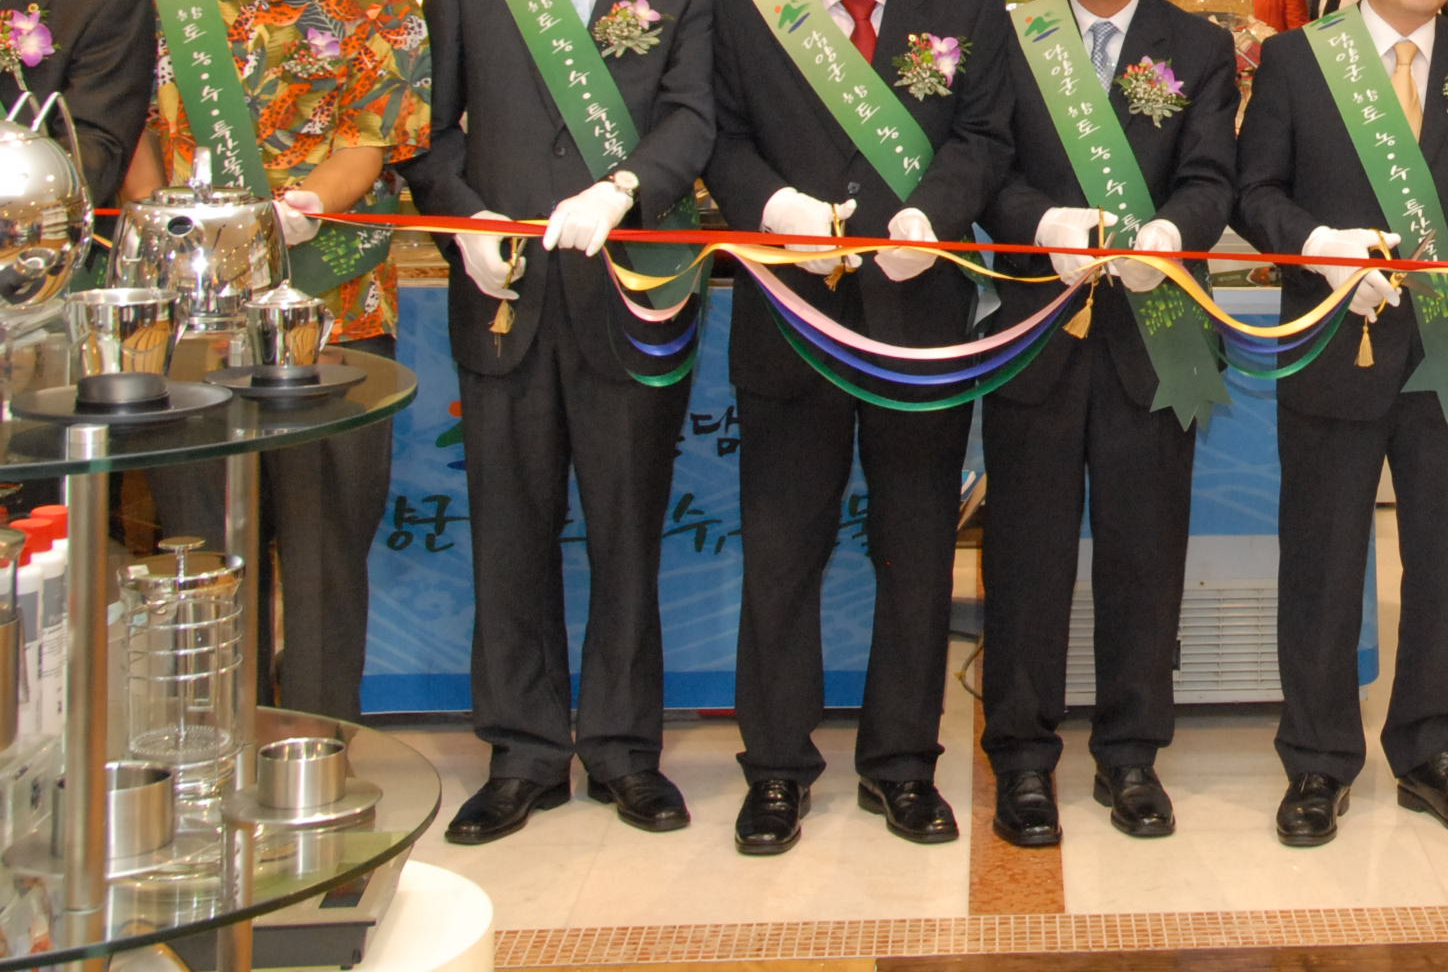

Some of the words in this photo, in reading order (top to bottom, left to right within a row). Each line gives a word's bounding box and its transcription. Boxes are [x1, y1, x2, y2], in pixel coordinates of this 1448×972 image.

[177, 6, 206, 44] 향토
[801, 30, 846, 83] 담양군
[842, 84, 881, 124] 향토
[1043, 43, 1079, 96] 담양군
[1067, 101, 1101, 139] 향토
[1327, 31, 1365, 82] 담양군
[1352, 88, 1386, 124] 향토
